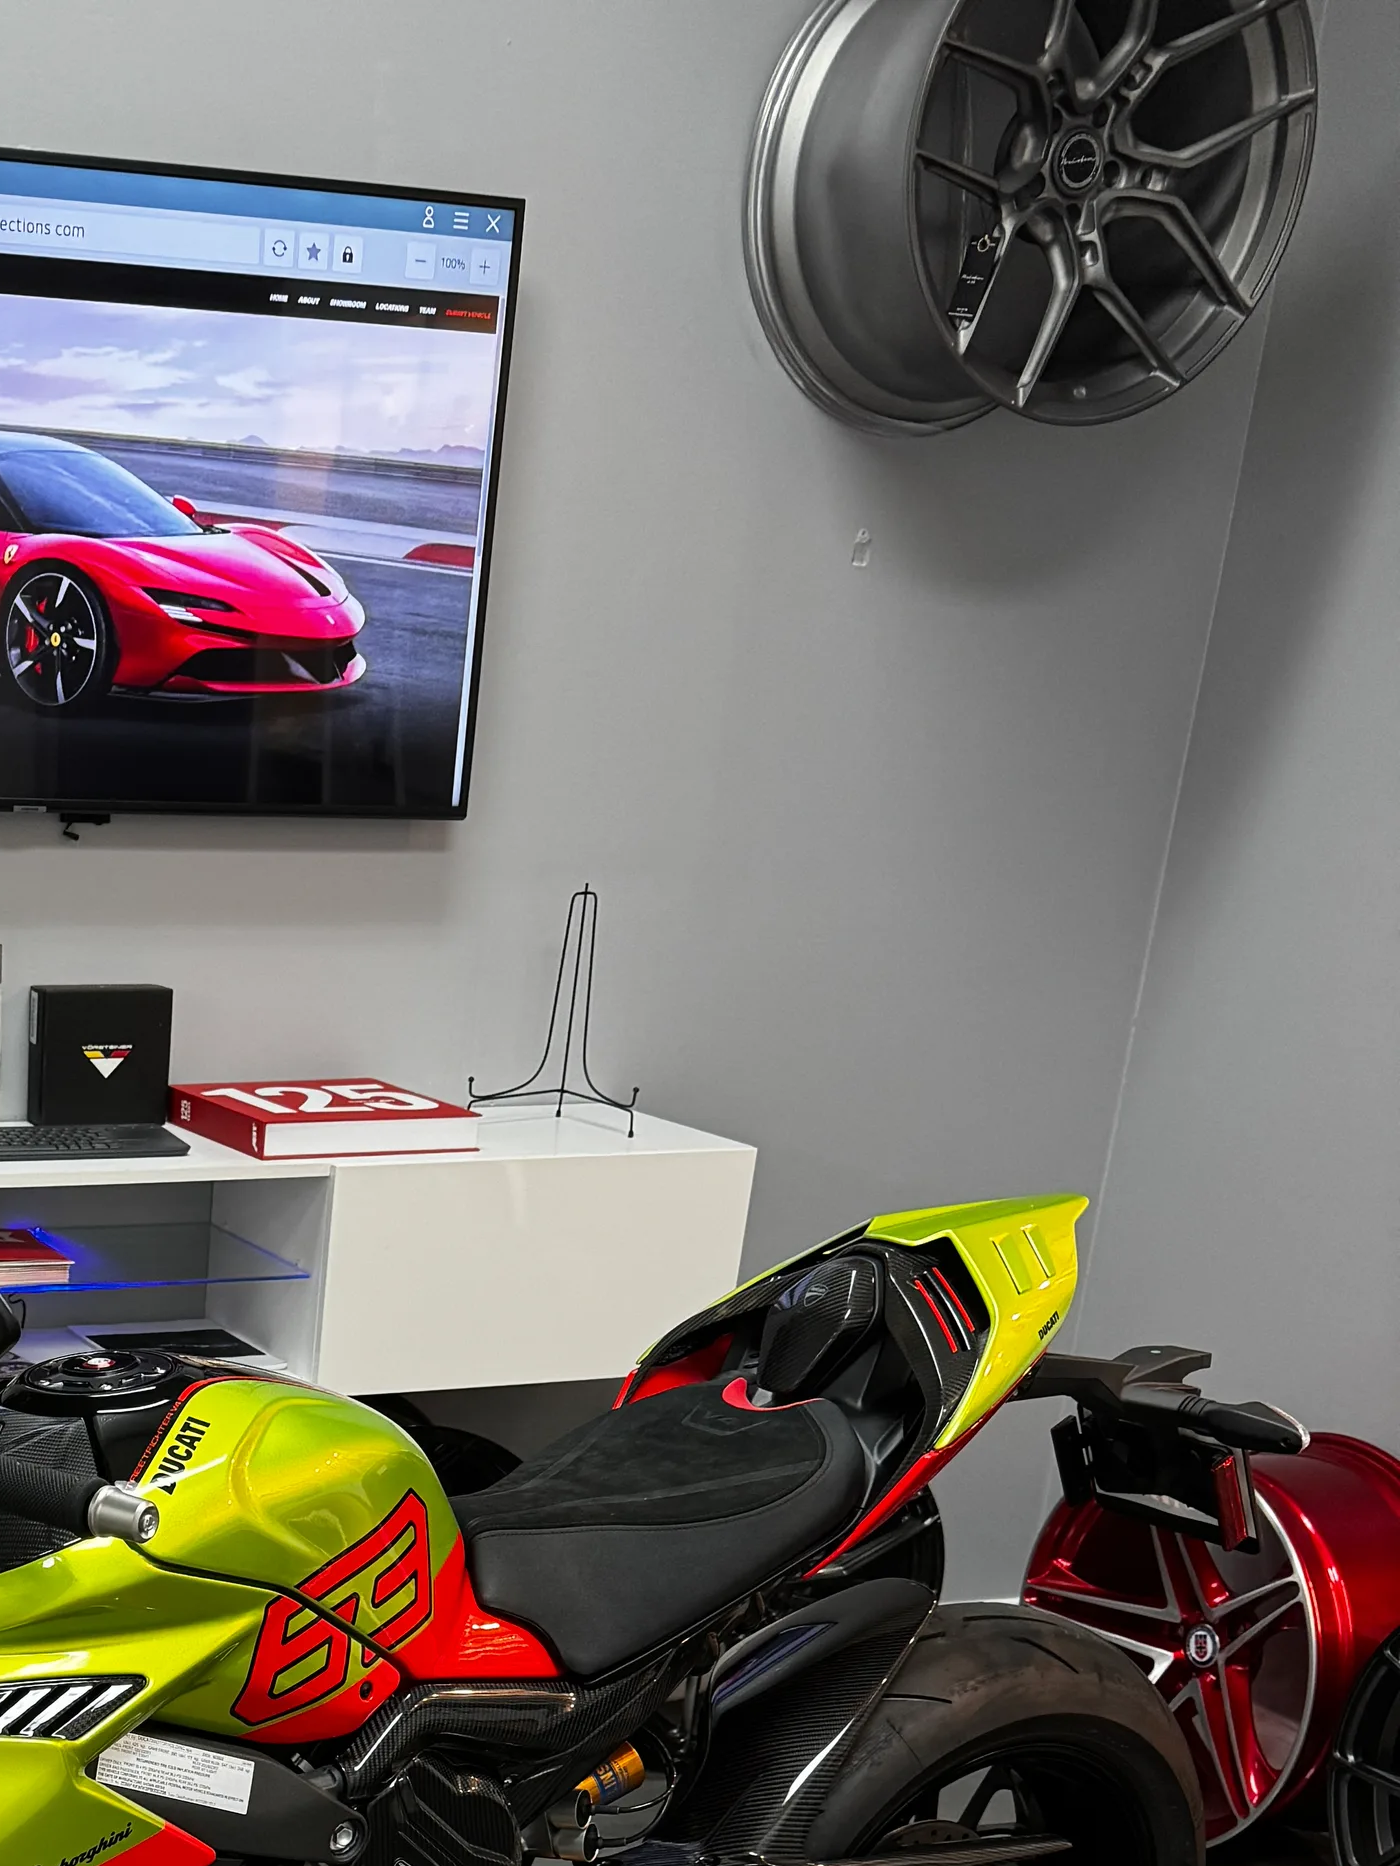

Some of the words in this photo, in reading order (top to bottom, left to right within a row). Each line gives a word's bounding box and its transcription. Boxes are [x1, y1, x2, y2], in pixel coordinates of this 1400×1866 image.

[441, 257, 466, 270] 100%
[297, 296, 321, 306] ABOUT
[200, 1084, 439, 1114] 125
[1038, 1311, 1060, 1341] DUCATI
